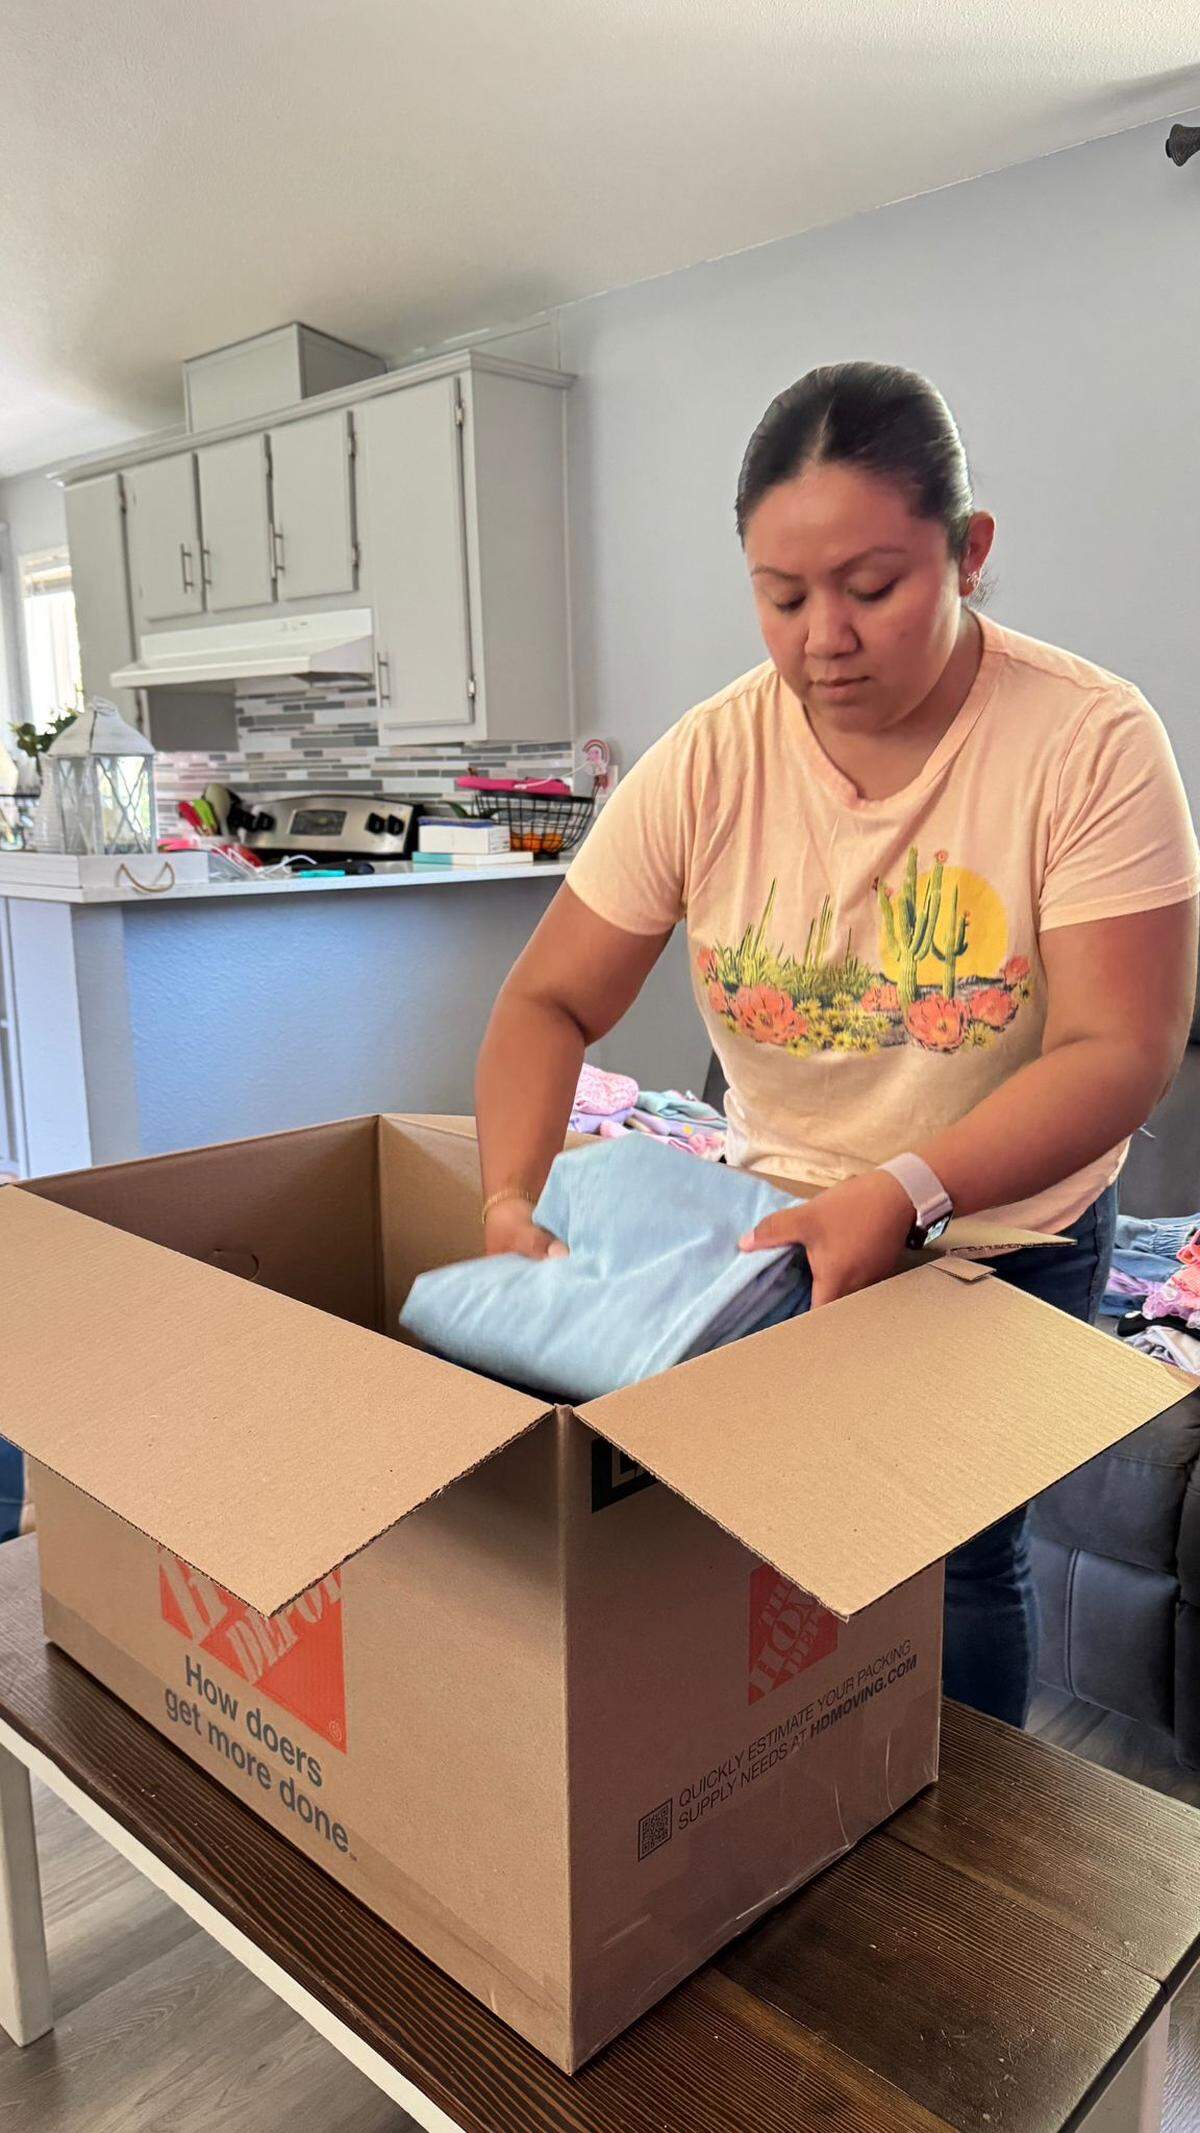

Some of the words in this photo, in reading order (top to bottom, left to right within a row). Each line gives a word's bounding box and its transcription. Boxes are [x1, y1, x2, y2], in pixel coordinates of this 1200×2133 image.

[165, 1688, 202, 1736] get
[208, 1720, 272, 1790] more
[186, 1654, 237, 1720] How
[246, 1707, 323, 1788] doers
[678, 1749, 746, 1807] QUICKLY
[748, 1703, 815, 1762] ESTIMATE
[817, 1676, 855, 1712] YOUR
[857, 1639, 912, 1686] PACKING
[678, 1777, 738, 1830] SUPPLY
[740, 1742, 788, 1789] NEEDS
[790, 1728, 808, 1753] AT
[810, 1653, 918, 1739] HDMOVING.COM
